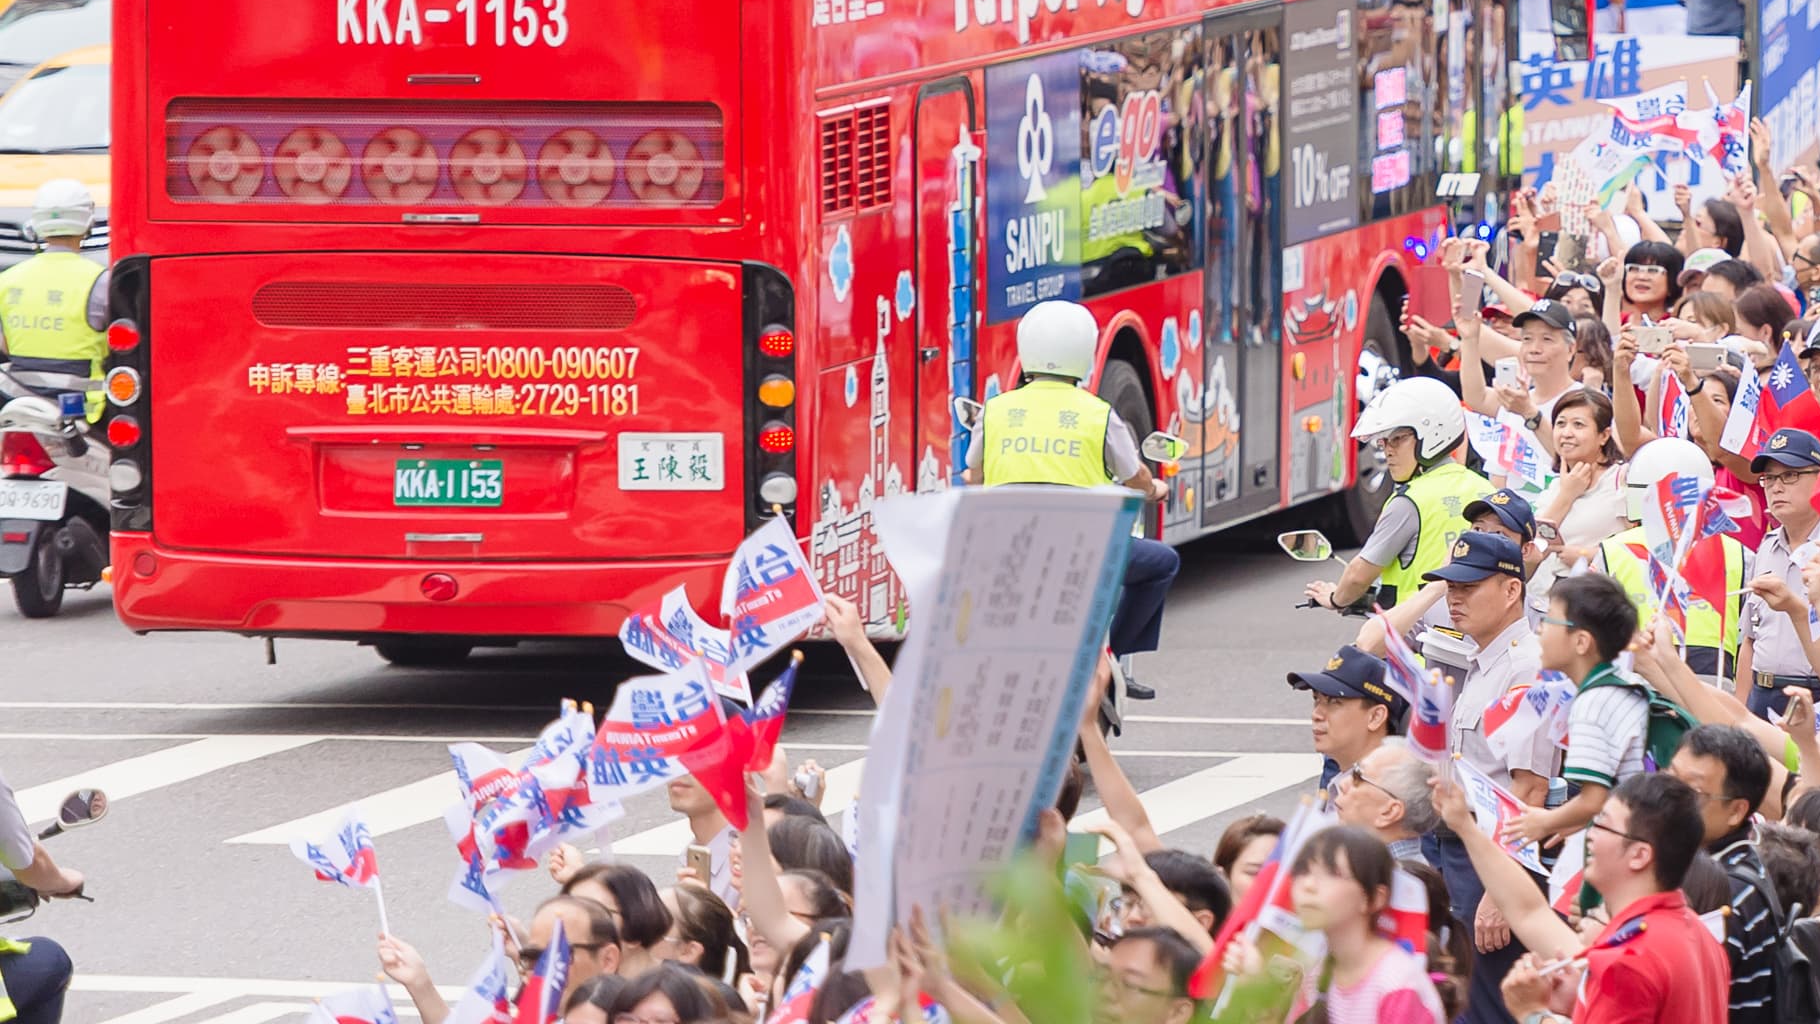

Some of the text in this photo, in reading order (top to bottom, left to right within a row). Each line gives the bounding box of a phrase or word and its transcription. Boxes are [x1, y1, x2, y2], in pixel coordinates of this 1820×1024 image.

[1523, 38, 1641, 112] 英雄
[1292, 143, 1350, 209] 10% OFF
[1005, 208, 1066, 275] SANPU
[248, 363, 346, 394] 申訴專線:
[1008, 408, 1080, 430] 警察
[1001, 437, 1082, 459] POLICE
[396, 468, 502, 500] KKA-1153
